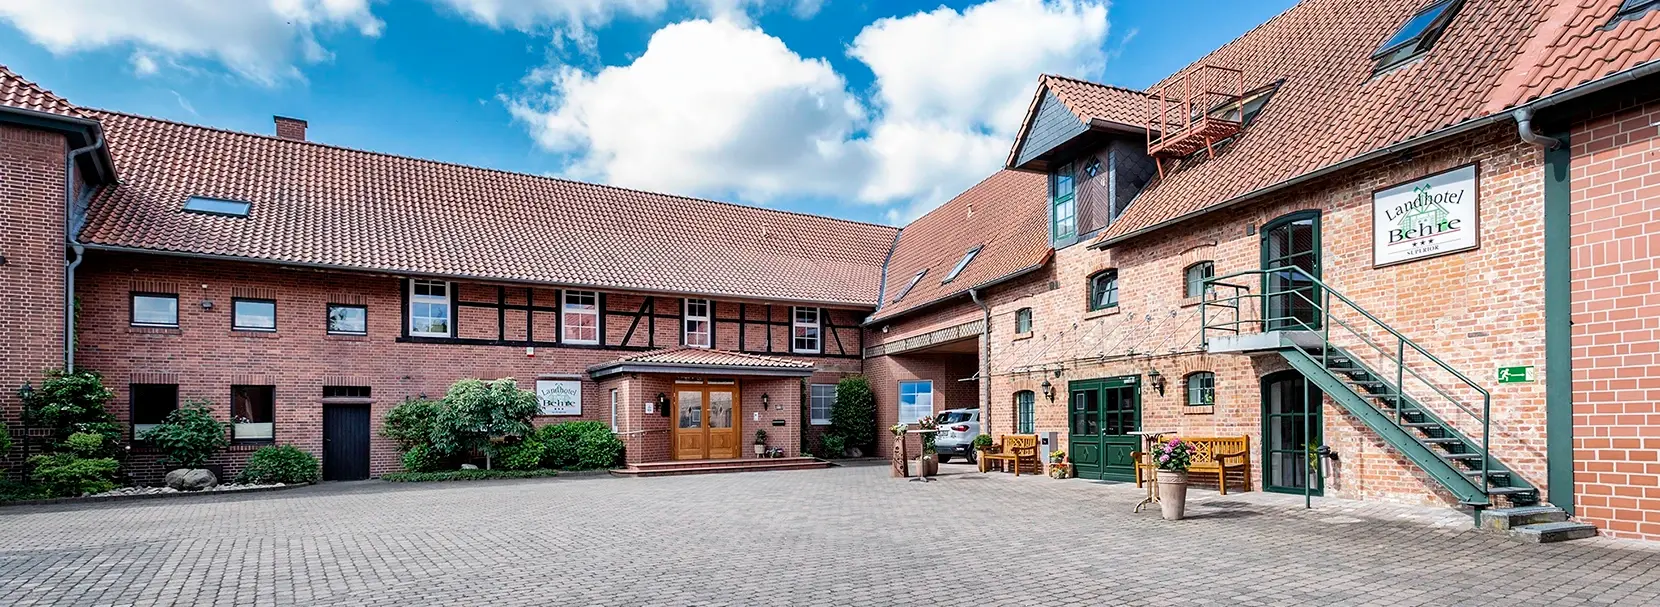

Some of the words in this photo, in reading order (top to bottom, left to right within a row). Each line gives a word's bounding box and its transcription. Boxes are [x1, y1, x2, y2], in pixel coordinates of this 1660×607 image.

[1385, 189, 1464, 221] Landhotel
[1388, 218, 1461, 243] Behre
[1407, 245, 1440, 255] SUPERIOR
[541, 386, 577, 396] Landhotel
[543, 399, 576, 407] Behre
